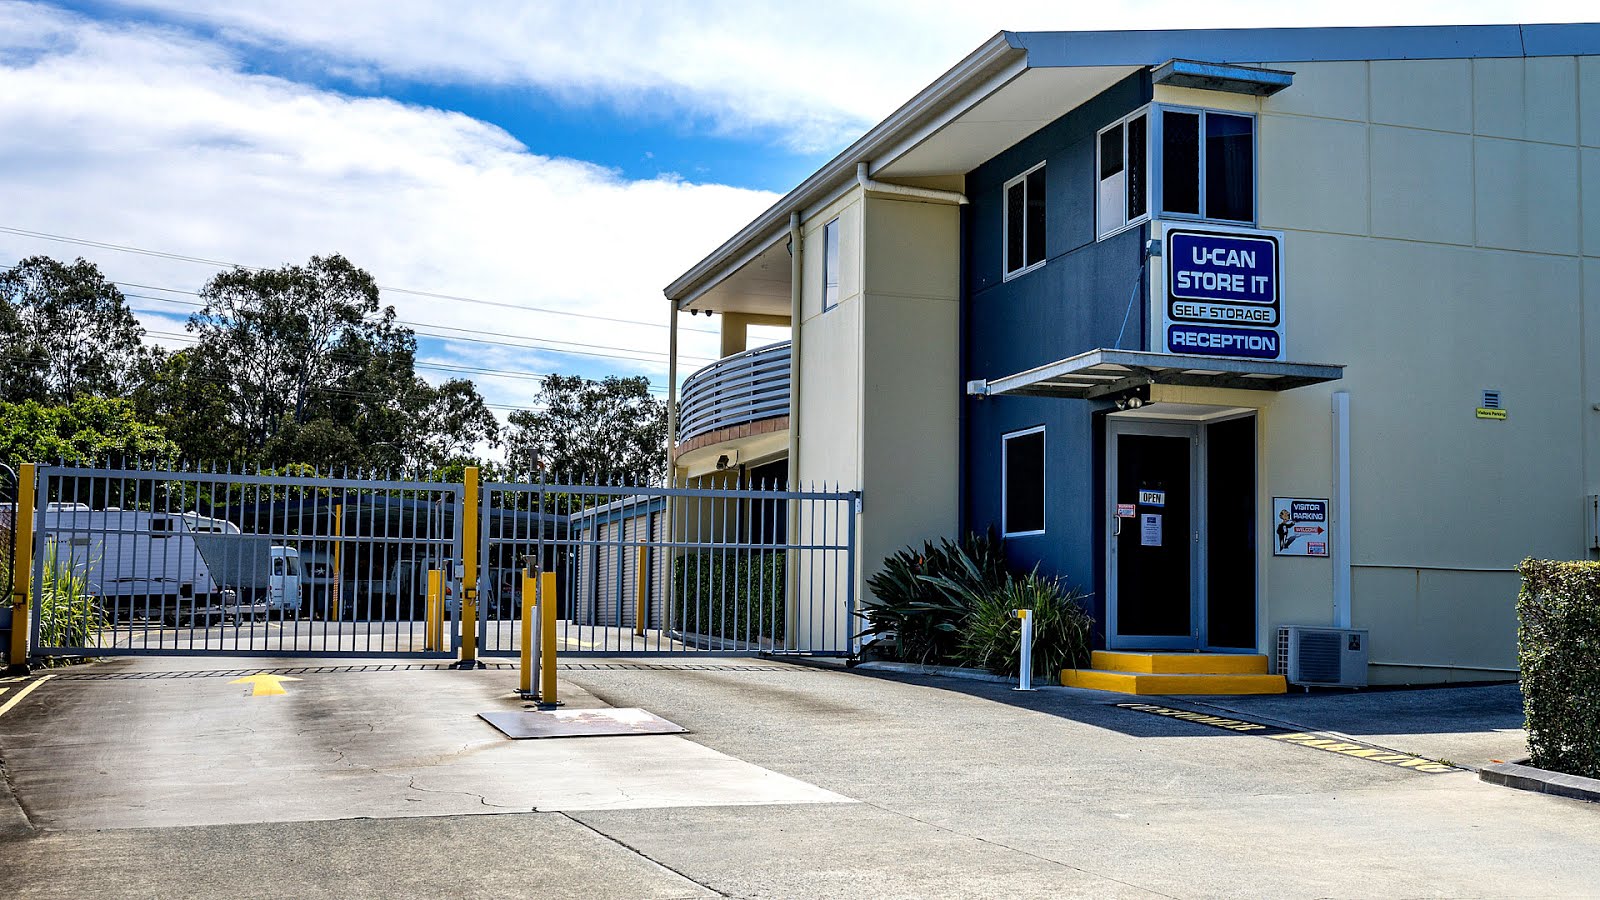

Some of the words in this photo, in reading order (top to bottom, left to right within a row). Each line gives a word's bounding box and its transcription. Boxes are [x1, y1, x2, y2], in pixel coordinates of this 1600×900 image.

[1192, 246, 1256, 269] U-CAN
[1177, 270, 1245, 292] STORE
[1251, 275, 1269, 294] IT
[1175, 304, 1207, 317] SELF
[1209, 307, 1270, 321] STORAGE
[1172, 331, 1276, 351] RECEPTION
[1143, 492, 1162, 504] OPEN
[1293, 503, 1320, 511] VISITOR
[1293, 512, 1323, 520] PARKING
[1266, 733, 1453, 774] PARKING
